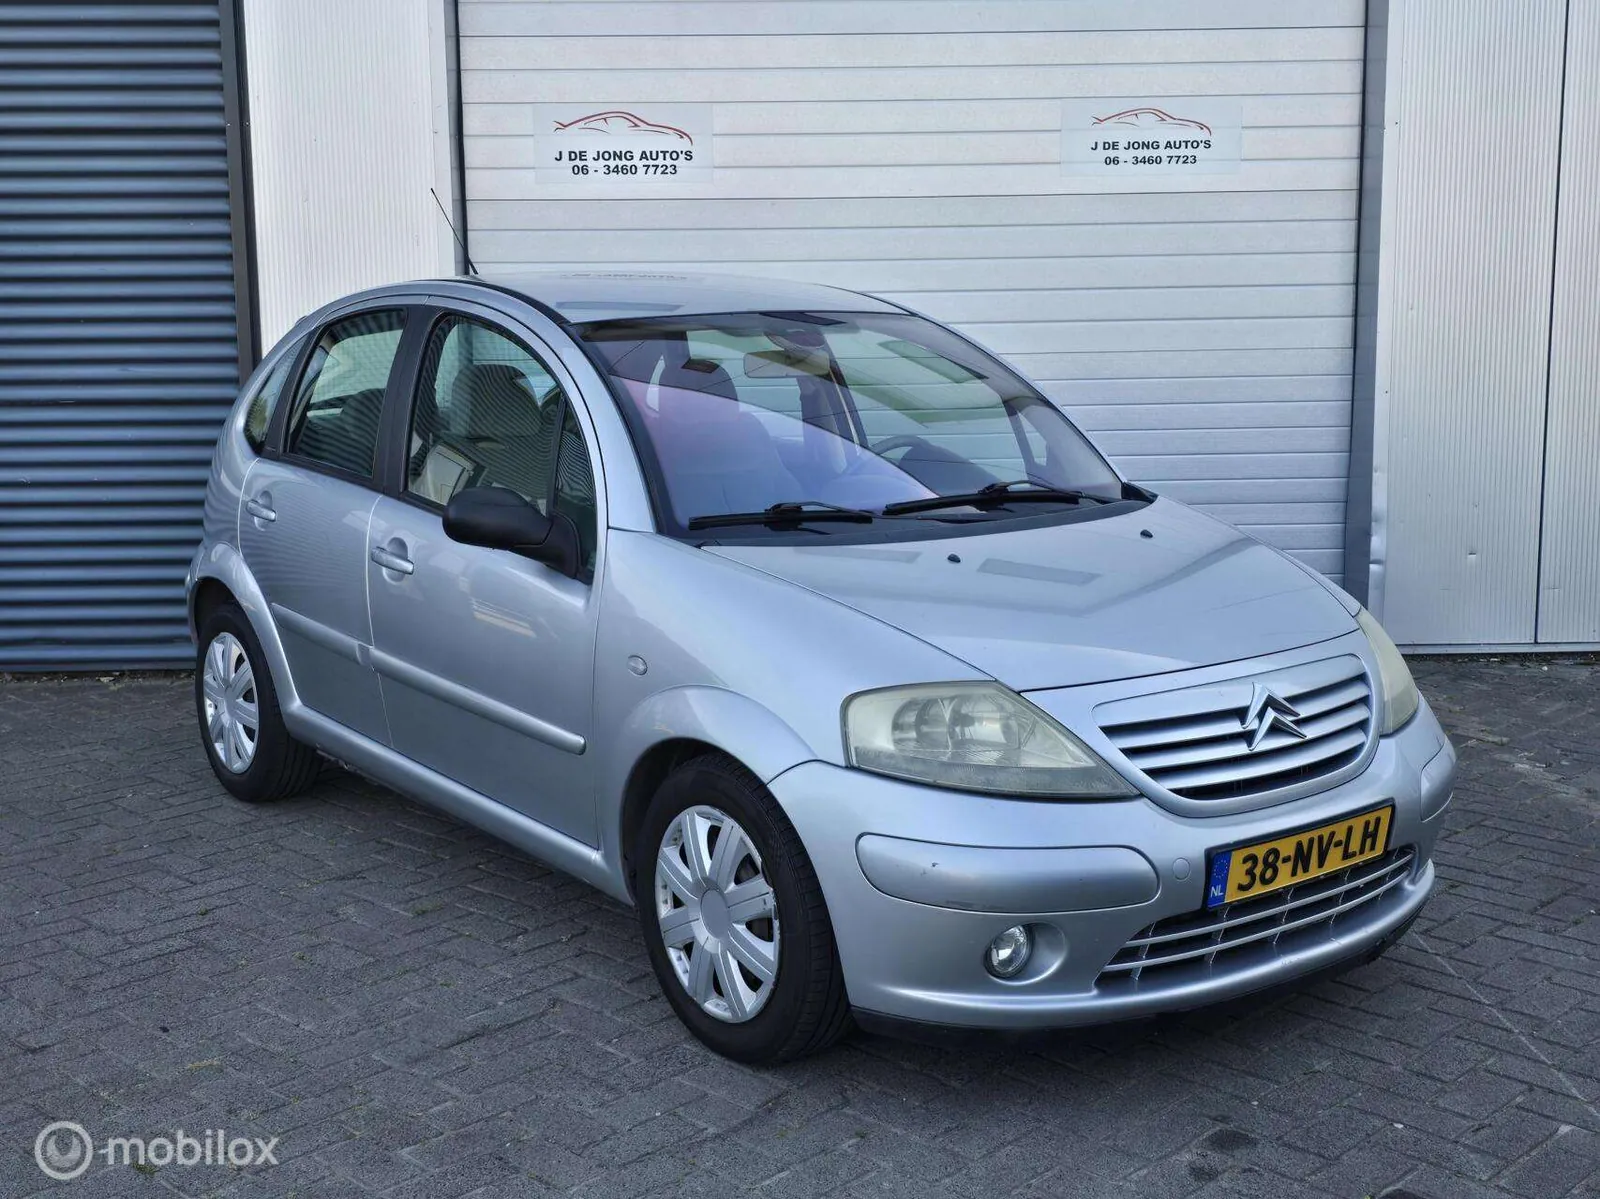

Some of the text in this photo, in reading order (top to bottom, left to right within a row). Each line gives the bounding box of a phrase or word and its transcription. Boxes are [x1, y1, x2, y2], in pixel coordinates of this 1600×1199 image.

[1091, 139, 1212, 151] J DE JONG AUTO'S
[554, 150, 693, 162] J DE JONG AUTO'S
[1104, 156, 1120, 166] 06
[1131, 155, 1162, 165] 3460
[1166, 155, 1197, 165] 7723
[571, 164, 589, 175] 06
[603, 164, 638, 175] 3460
[643, 164, 677, 175] 7723
[1237, 816, 1381, 892] 38-NV-LH
[1210, 885, 1224, 897] NL
